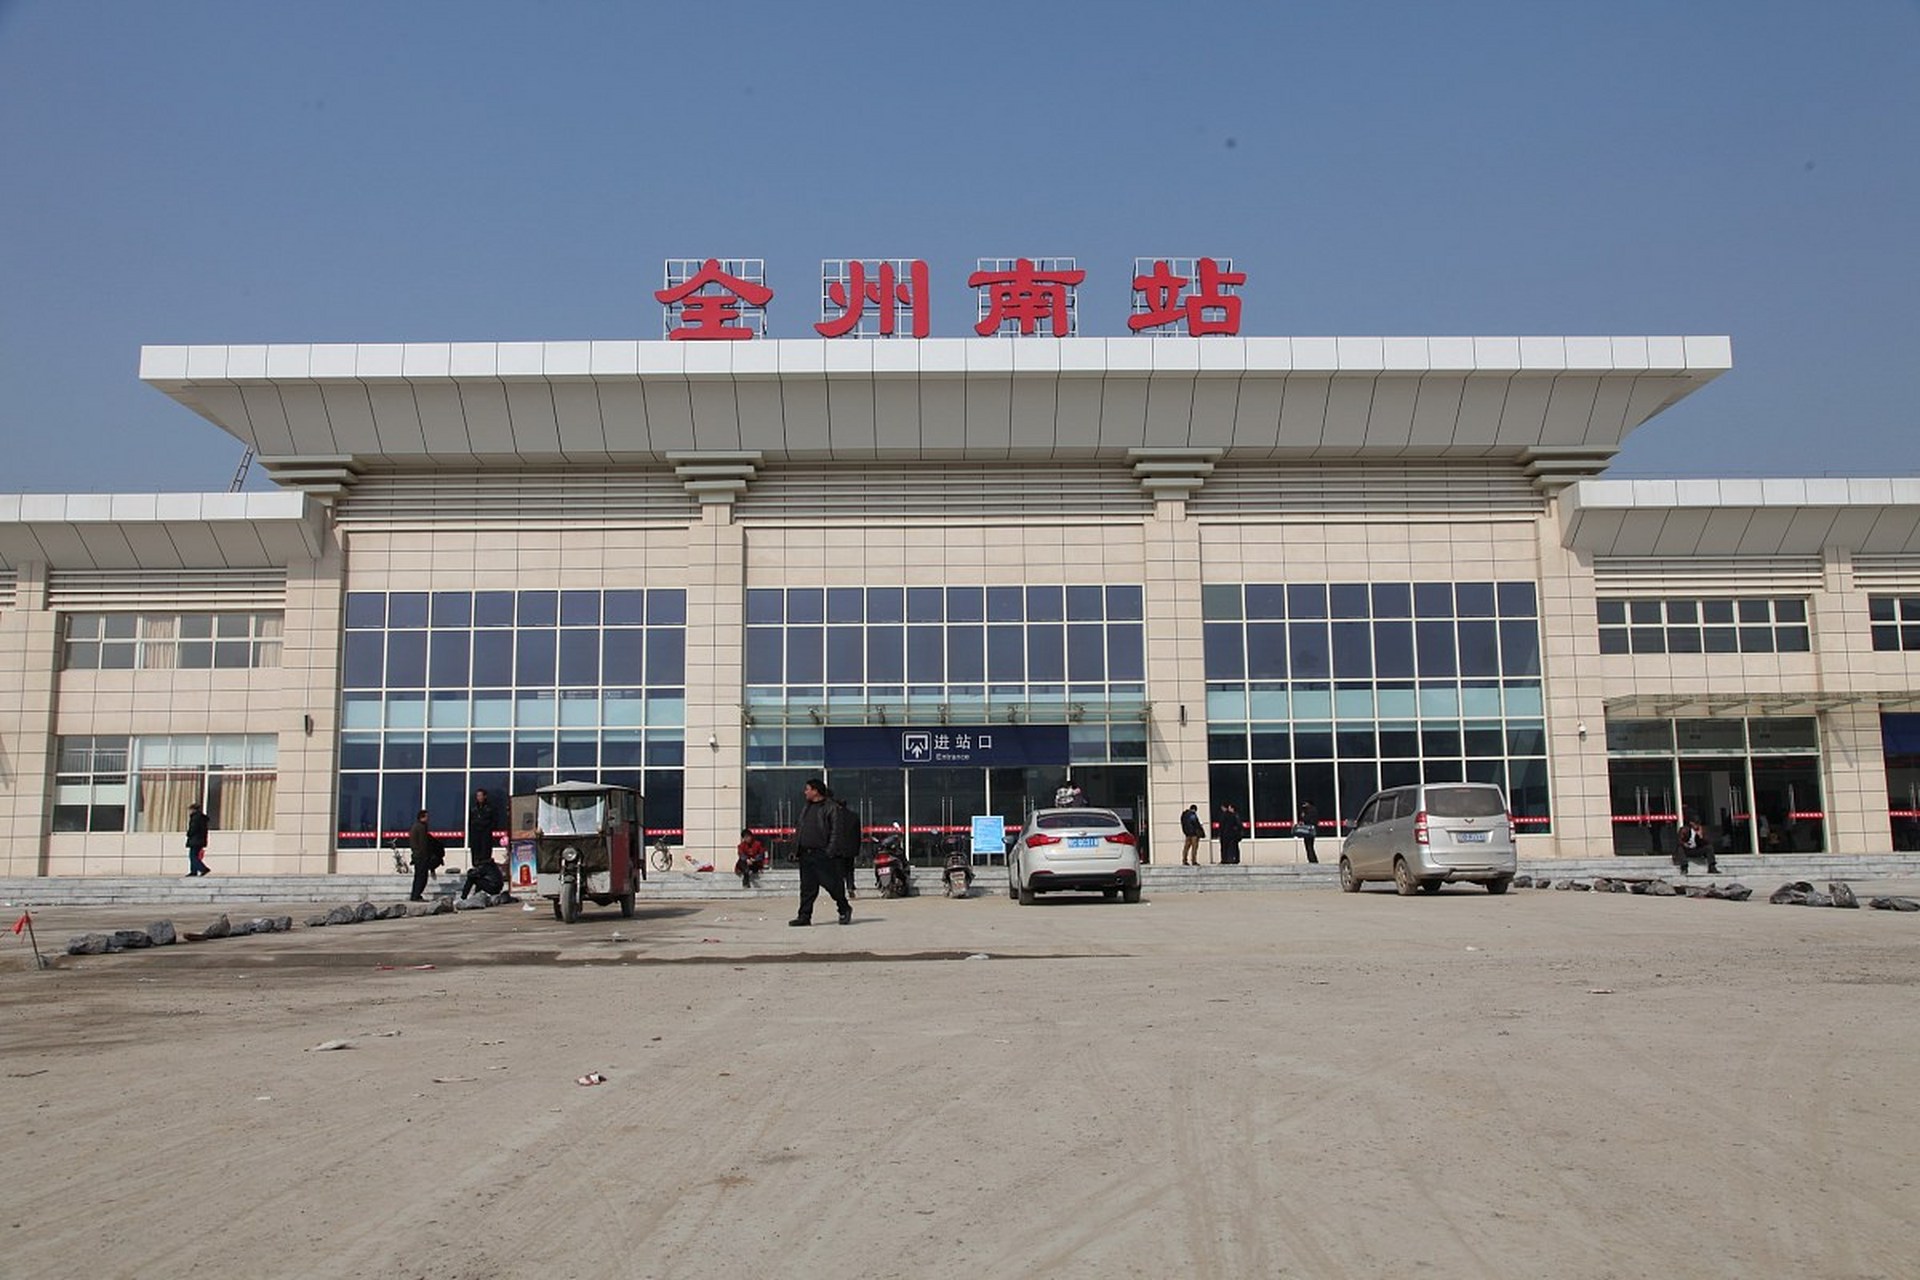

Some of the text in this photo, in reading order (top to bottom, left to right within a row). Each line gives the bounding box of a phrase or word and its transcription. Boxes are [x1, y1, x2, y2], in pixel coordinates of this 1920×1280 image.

[654, 257, 1246, 341] 全州南站
[933, 734, 992, 750] 进站口
[935, 753, 970, 761] Entrance
